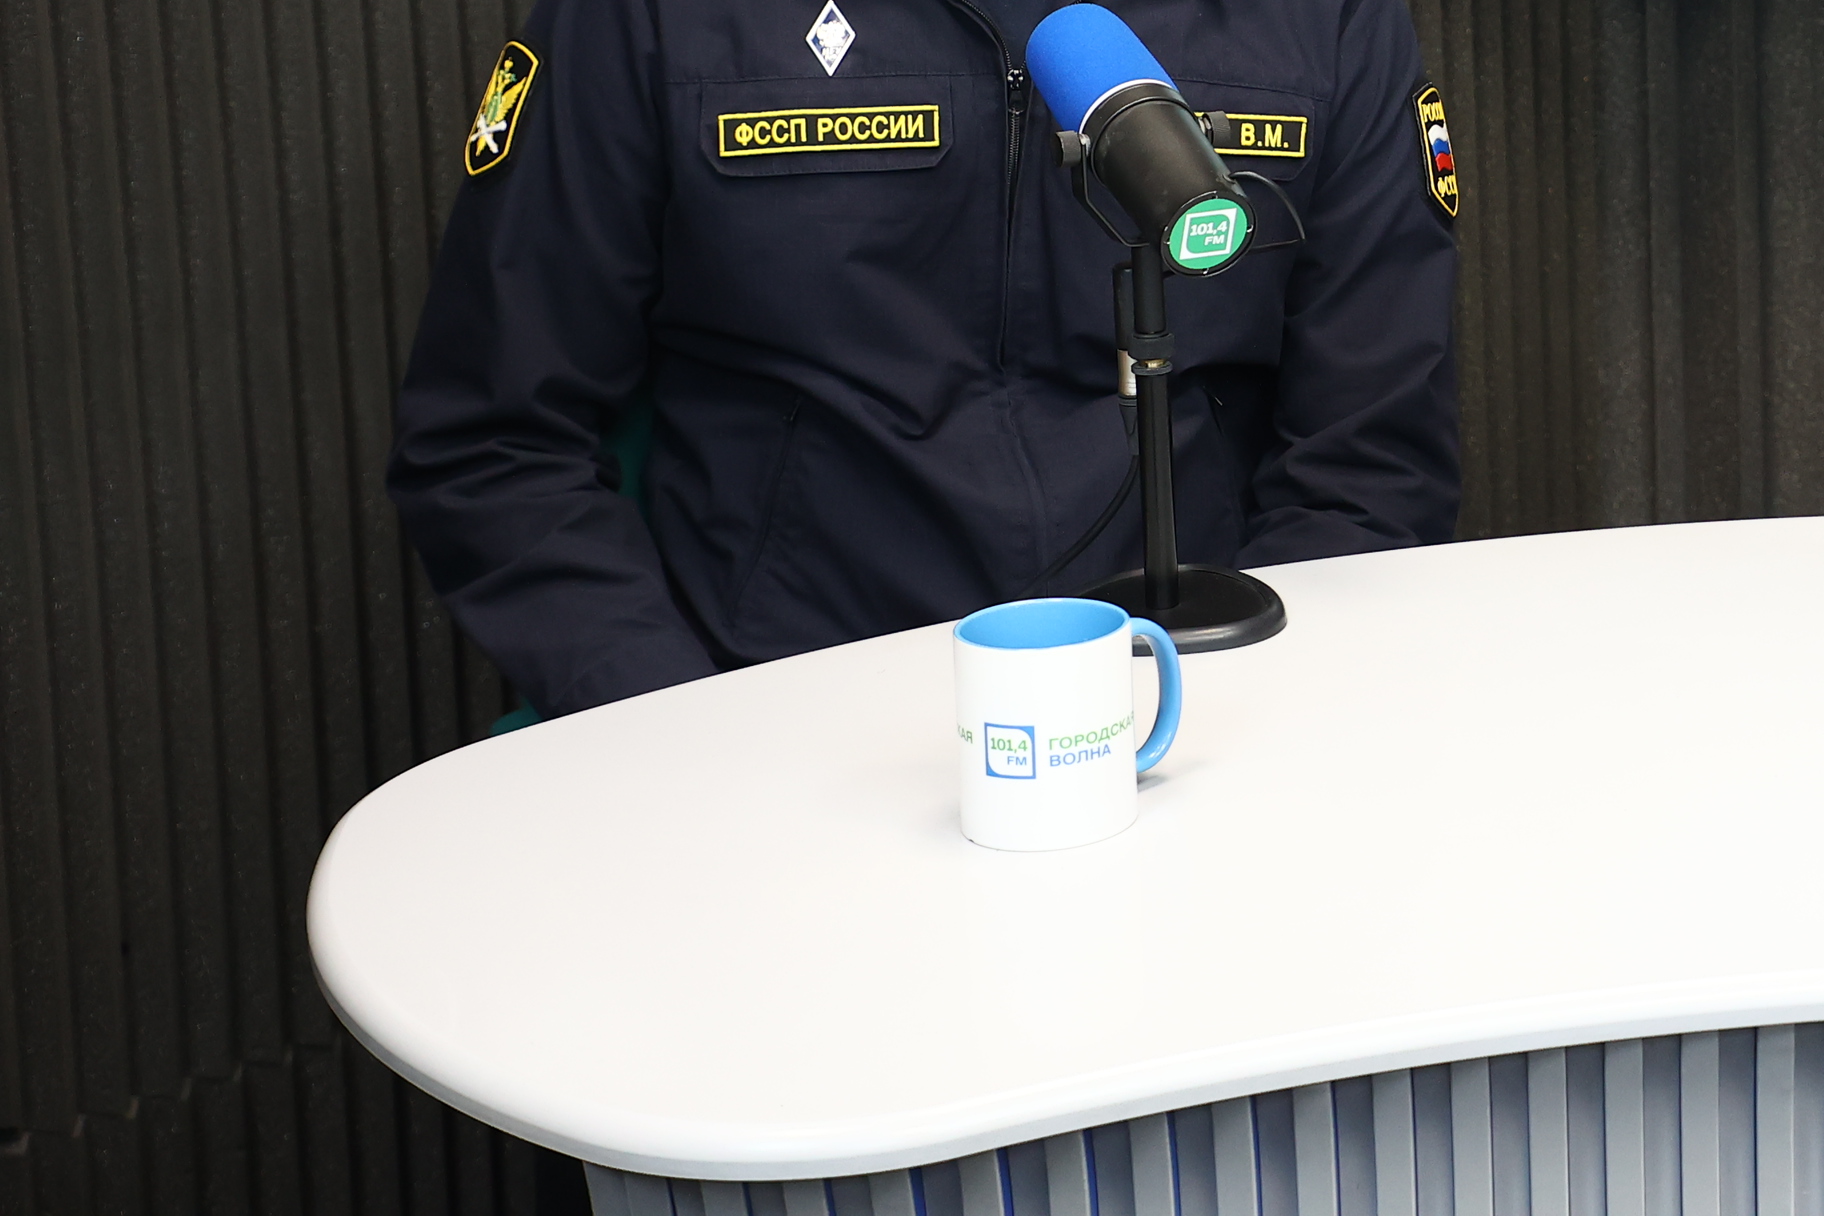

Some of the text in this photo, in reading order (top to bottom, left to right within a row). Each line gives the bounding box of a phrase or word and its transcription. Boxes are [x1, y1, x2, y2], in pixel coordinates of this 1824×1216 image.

[735, 112, 926, 148] ФССП РОССИИ
[1240, 122, 1290, 148] В.М.
[1189, 220, 1228, 237] 101,4
[1204, 234, 1226, 246] FM
[990, 737, 1028, 754] 101,4
[1007, 755, 1027, 766] FM
[1049, 743, 1111, 767] ВОЛНА
